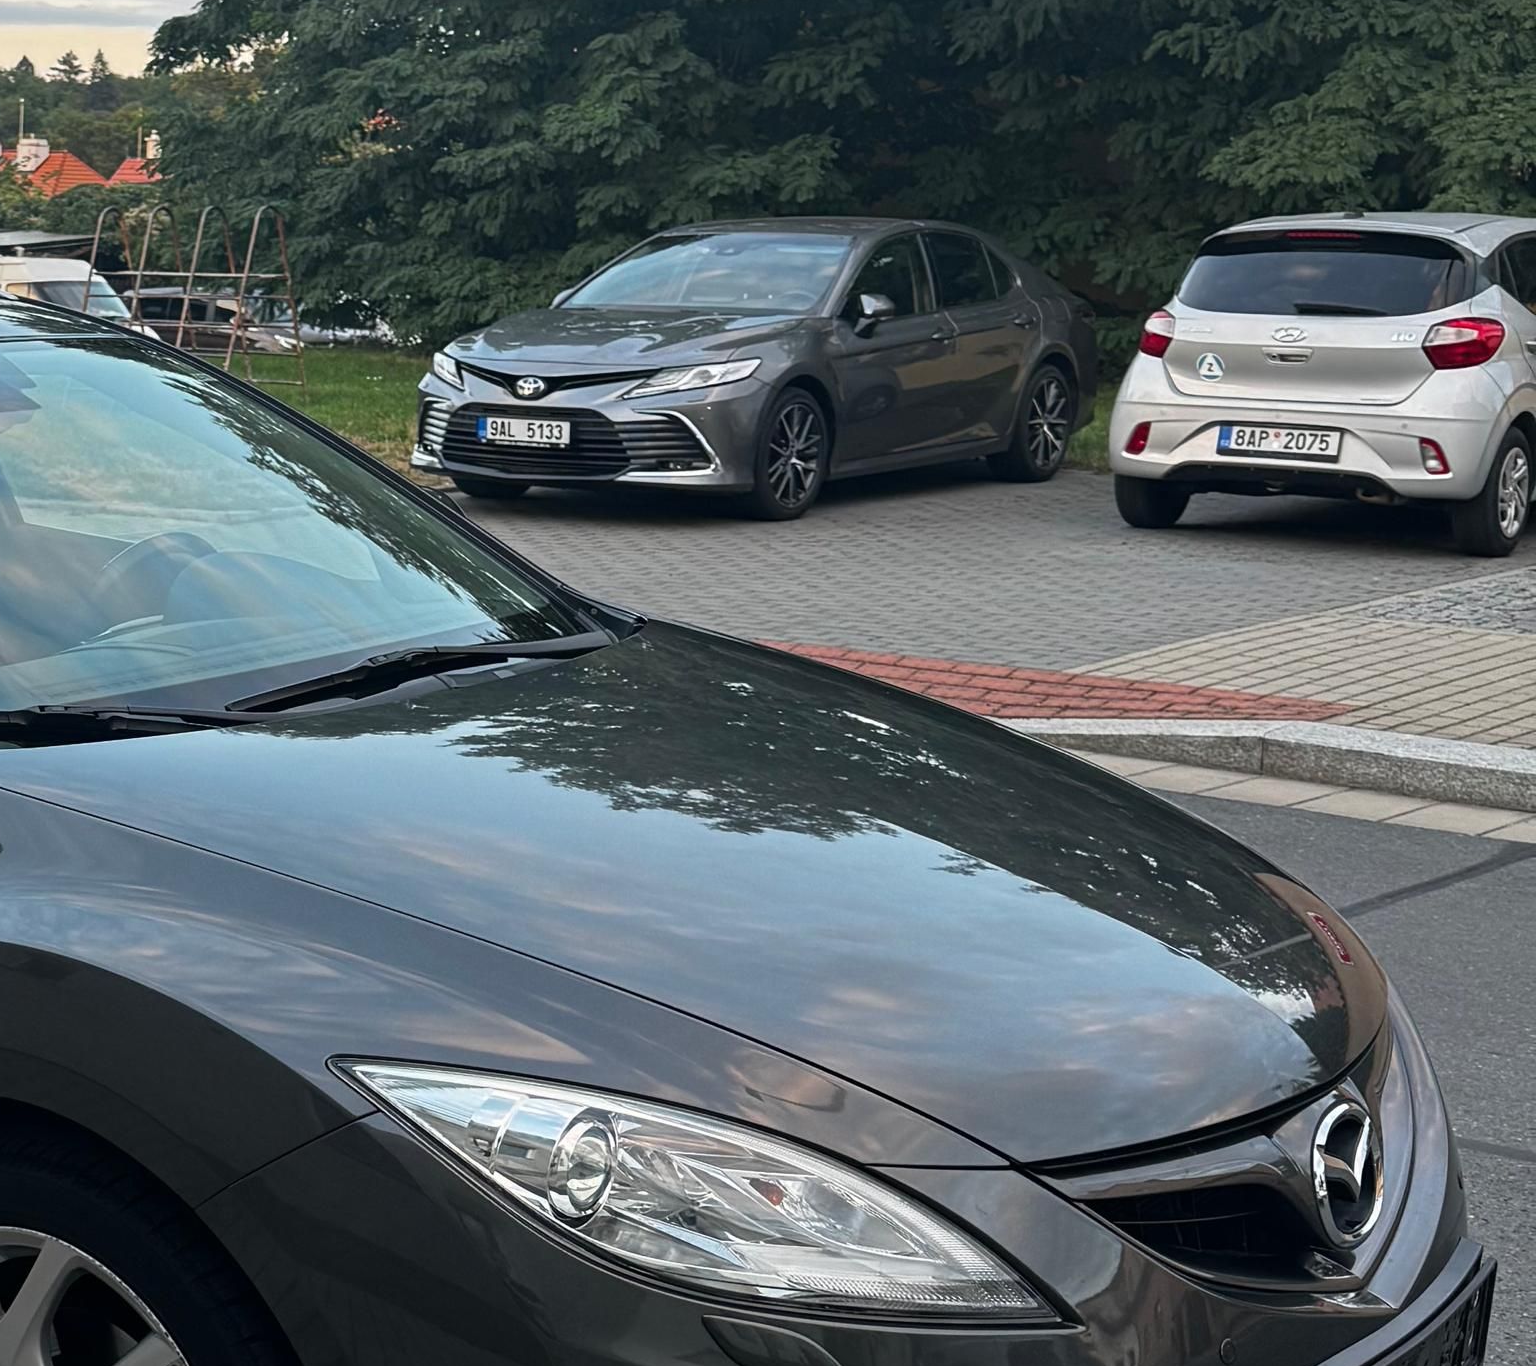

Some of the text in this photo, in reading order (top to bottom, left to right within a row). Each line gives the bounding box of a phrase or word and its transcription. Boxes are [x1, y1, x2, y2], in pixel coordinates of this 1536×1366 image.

[490, 420, 563, 440] 9AL 5133
[1234, 429, 1331, 451] 8AP 2075
